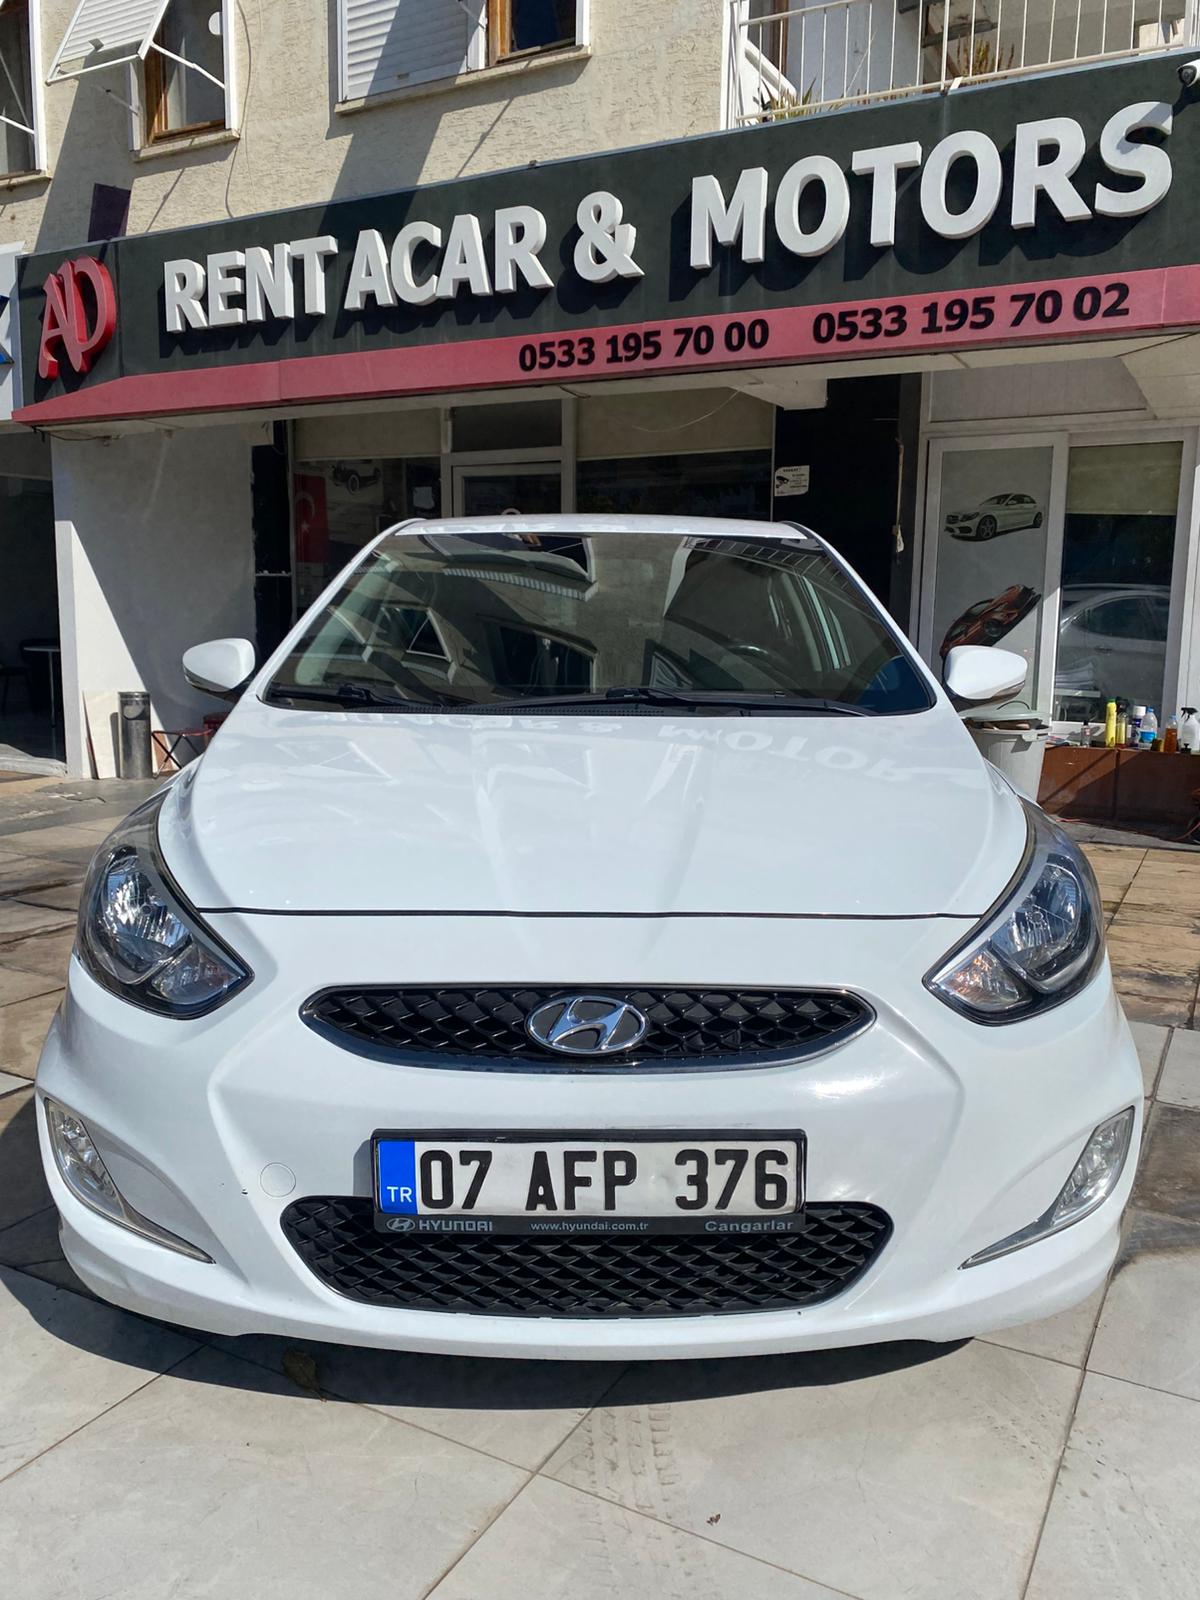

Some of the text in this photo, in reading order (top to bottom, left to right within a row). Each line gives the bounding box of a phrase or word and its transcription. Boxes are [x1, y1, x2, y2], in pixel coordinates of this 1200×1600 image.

[163, 235, 338, 333] RENT
[573, 190, 645, 283] &
[689, 101, 1174, 270] MOTORS
[519, 282, 1130, 372] 0533 195 70 00 0533 195 70 02
[386, 1148, 789, 1211] TR 07 AFP 376
[418, 1218, 795, 1234] HYUNDAI www.hyundai.com.tr Cangarlar
